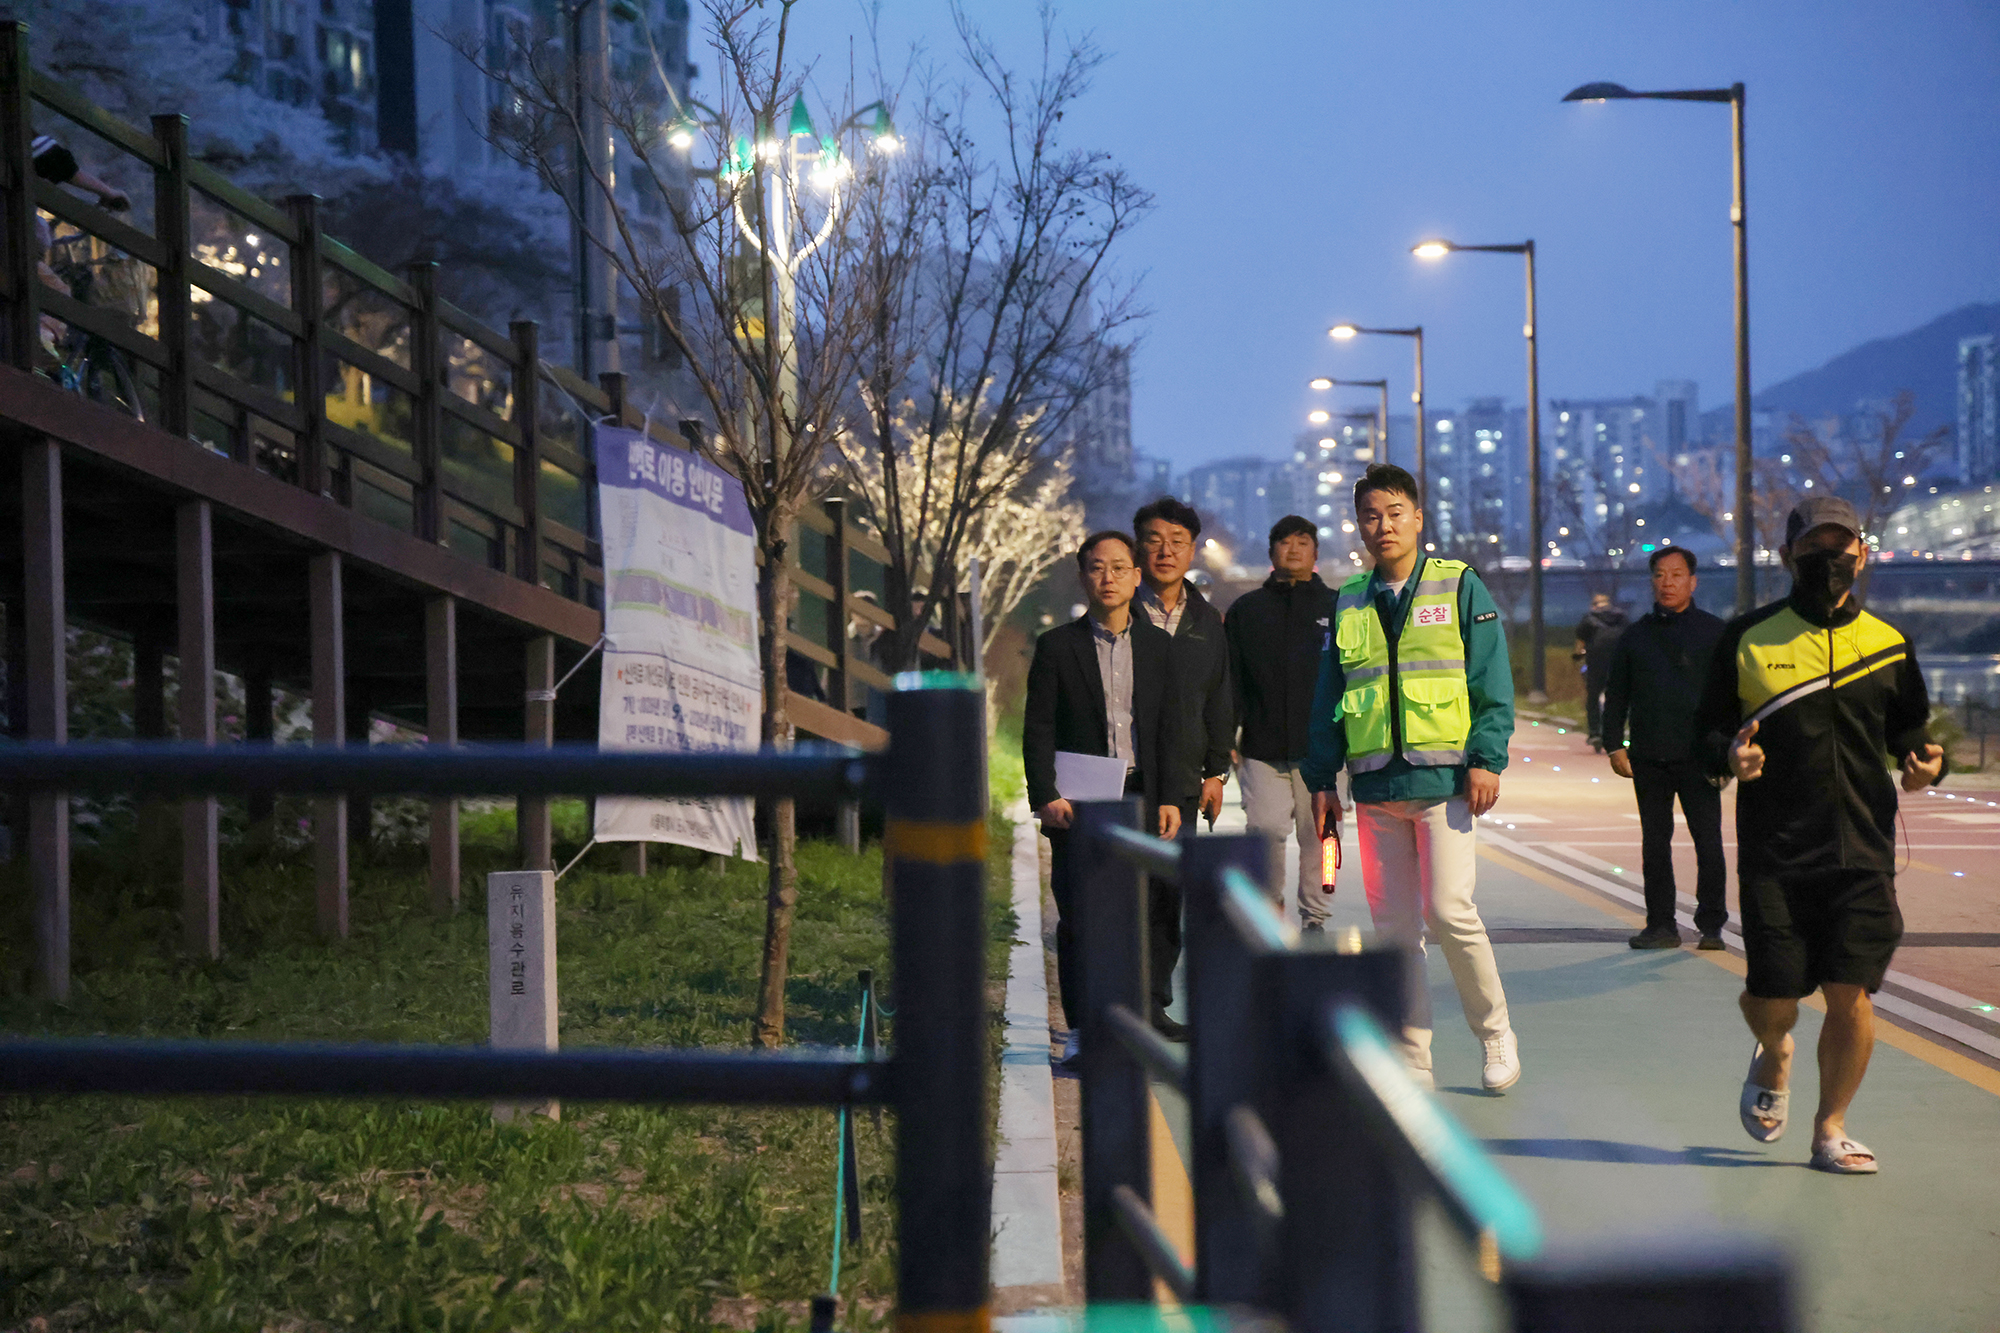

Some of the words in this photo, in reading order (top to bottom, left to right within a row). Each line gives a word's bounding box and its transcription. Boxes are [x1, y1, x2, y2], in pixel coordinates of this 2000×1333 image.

[659, 452, 686, 498] 이용
[688, 463, 724, 515] 안내문
[1418, 606, 1448, 624] 순찰
